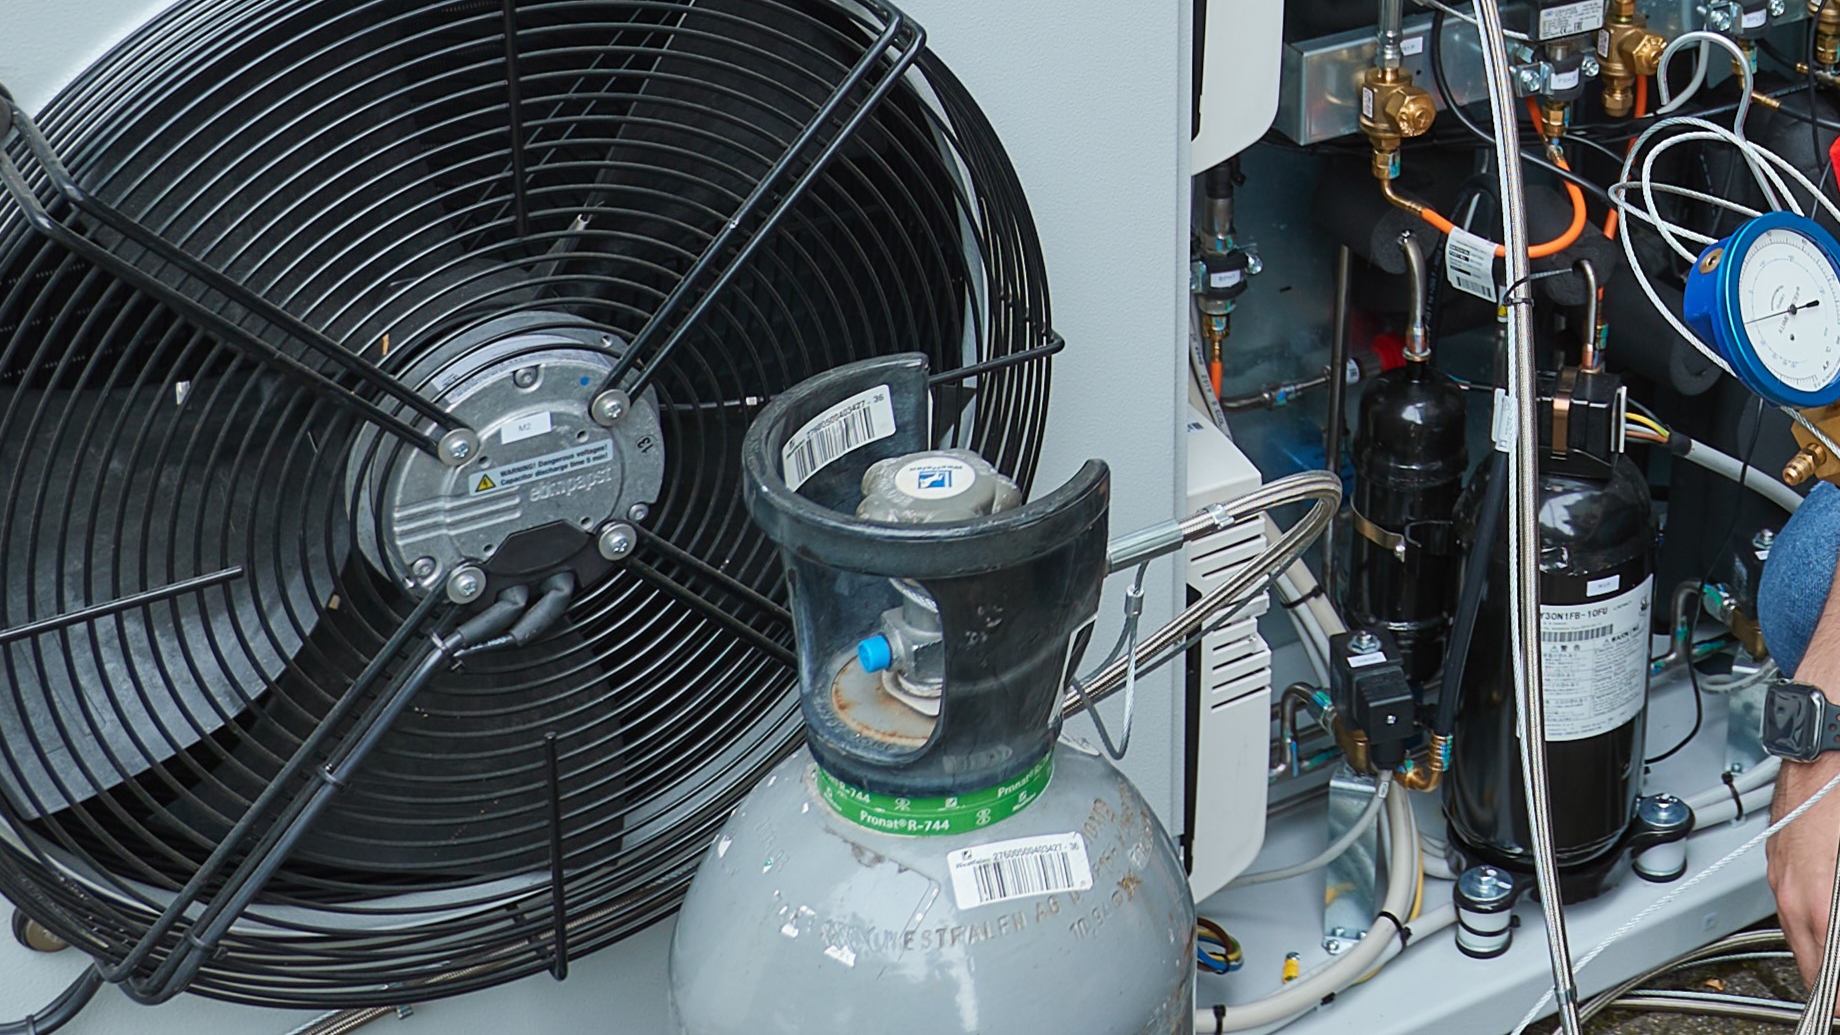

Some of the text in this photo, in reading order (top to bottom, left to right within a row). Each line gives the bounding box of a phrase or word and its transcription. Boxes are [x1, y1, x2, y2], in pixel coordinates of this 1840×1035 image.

[873, 394, 884, 403] 36
[518, 421, 532, 433] M2
[637, 436, 654, 453] 13
[499, 445, 608, 478] WARNING! Dangerous voltages!
[500, 472, 533, 487] Capacitor
[534, 465, 569, 481] discharge
[569, 460, 586, 471] time
[592, 452, 608, 463] min!
